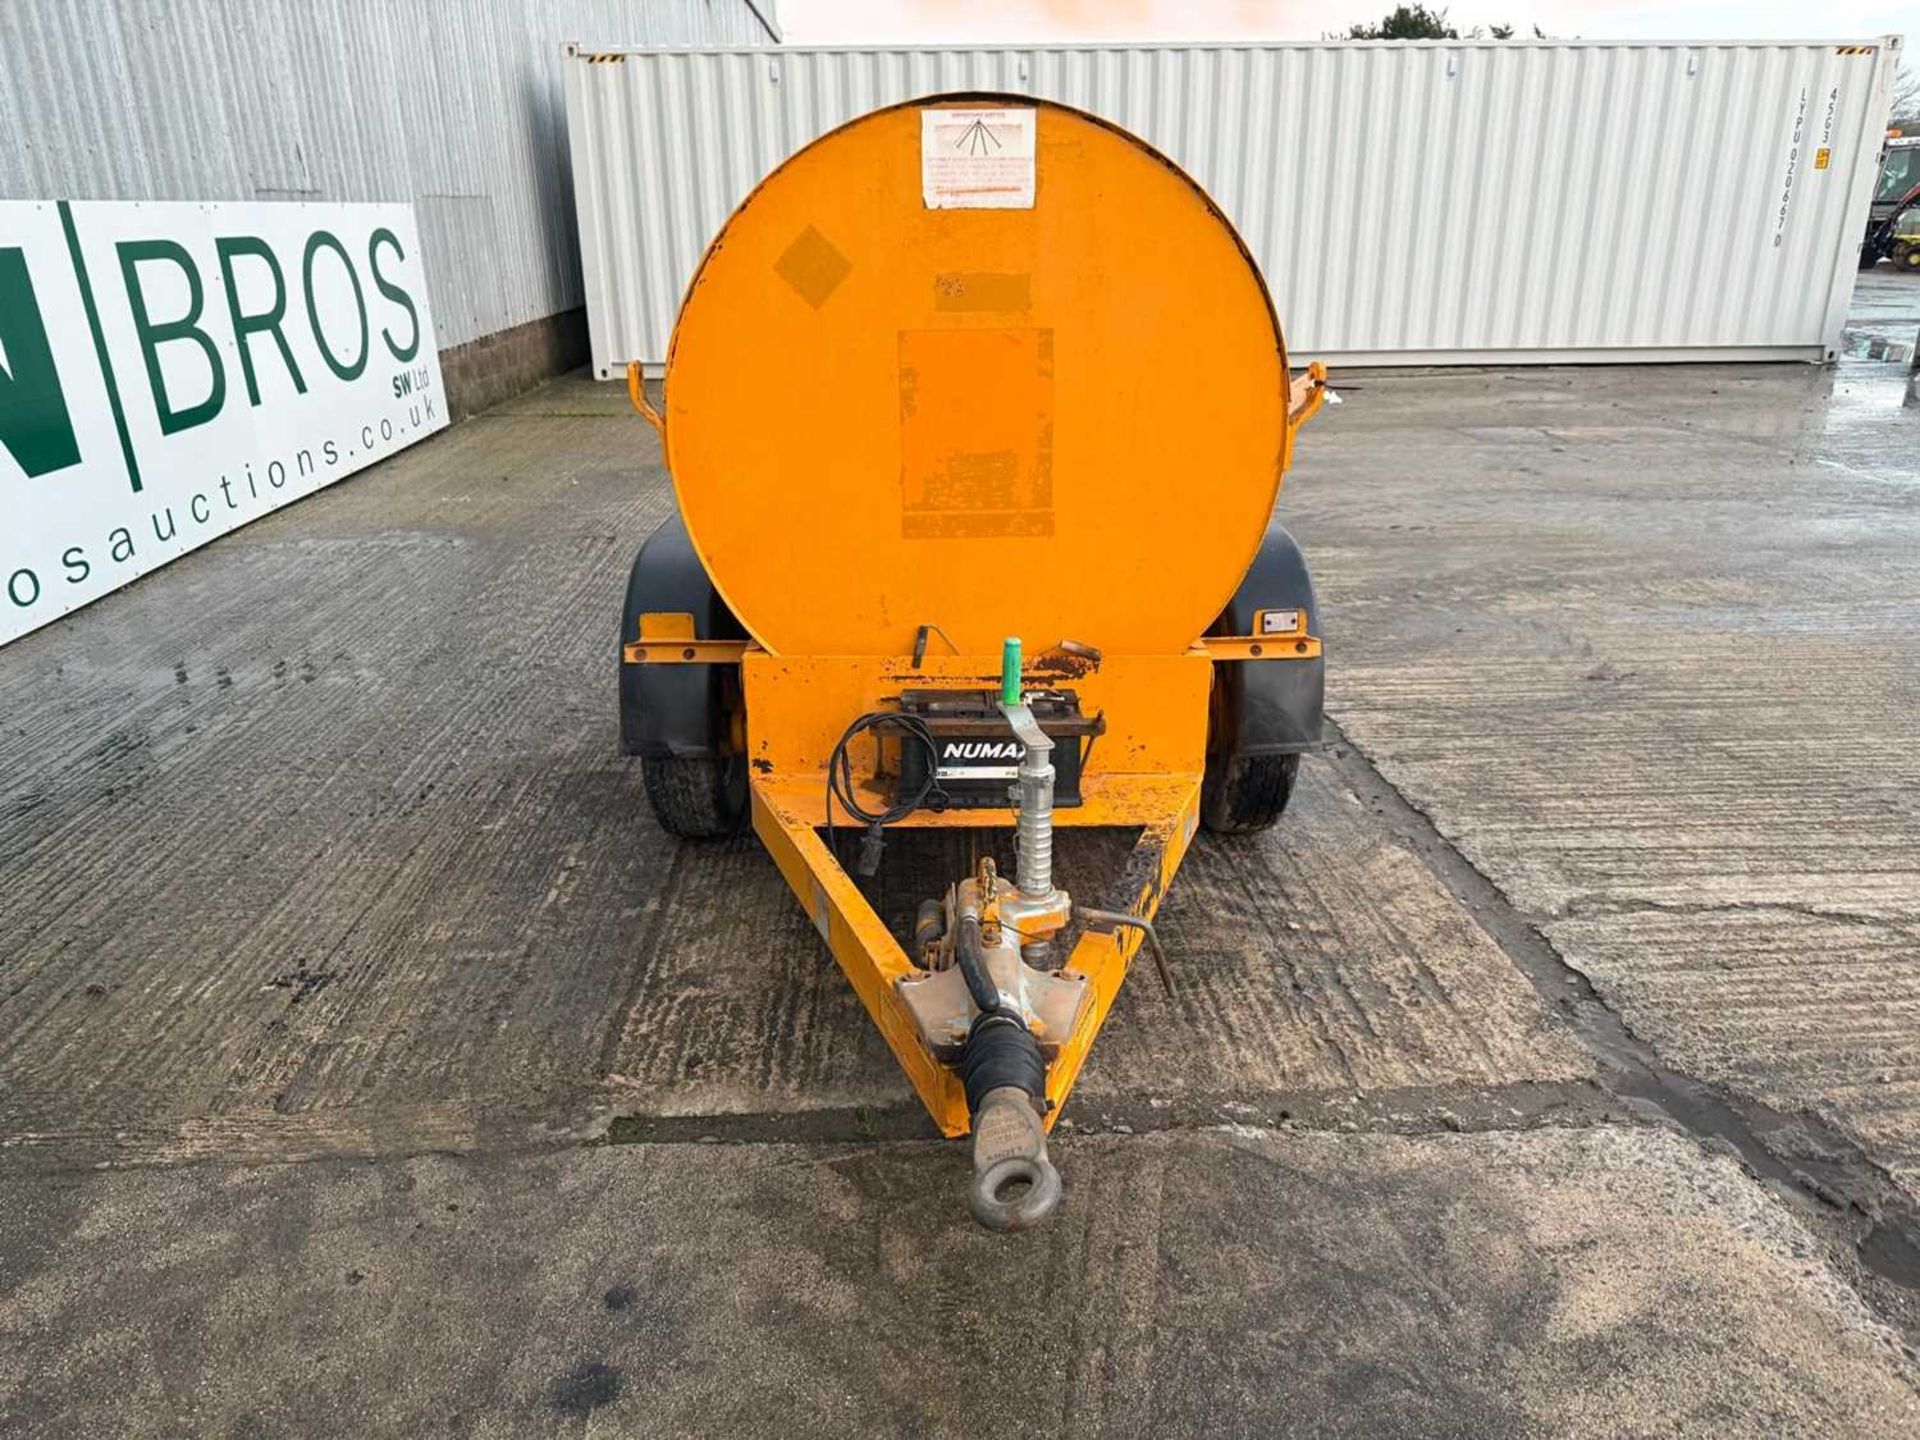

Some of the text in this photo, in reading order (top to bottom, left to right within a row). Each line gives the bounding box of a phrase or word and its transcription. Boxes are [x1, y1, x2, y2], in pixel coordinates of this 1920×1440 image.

[115, 228, 420, 437] BROS
[392, 364, 430, 399] SW Ltd
